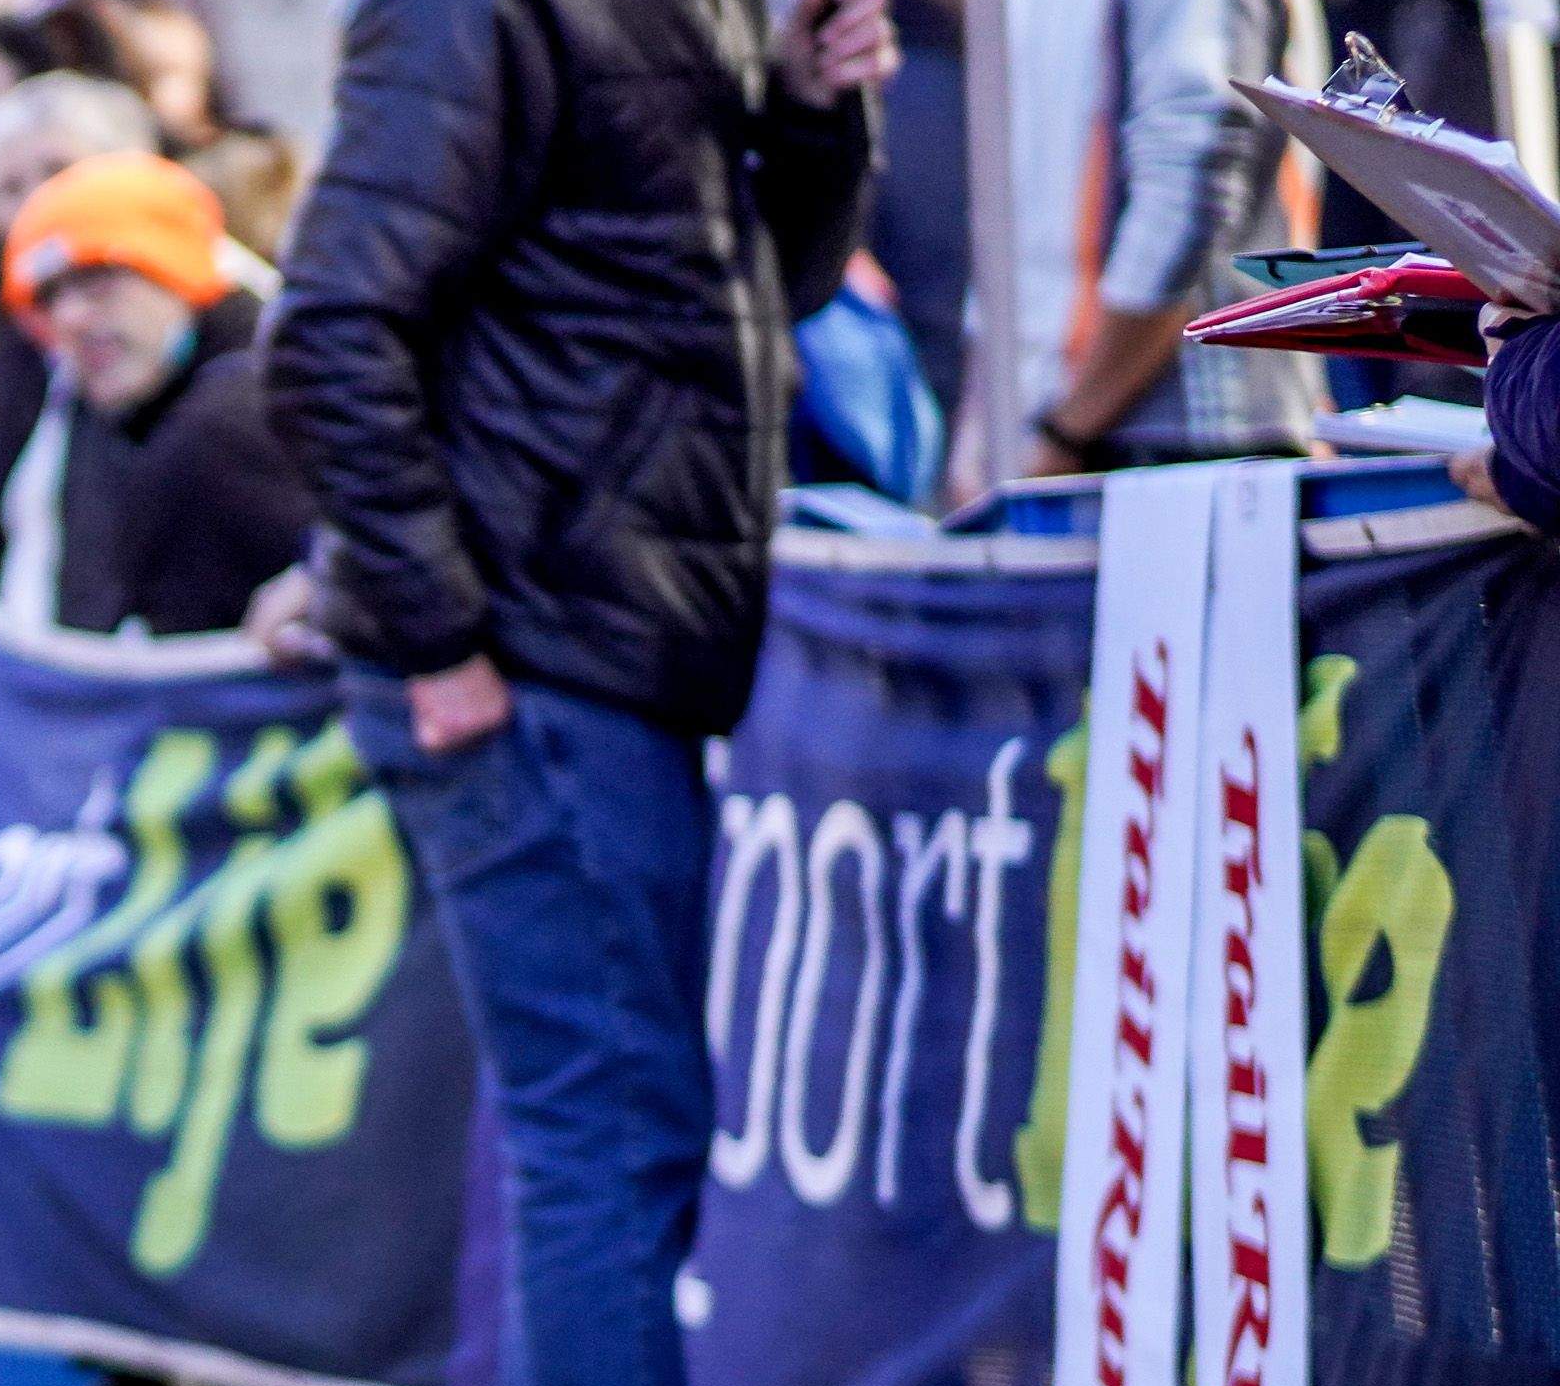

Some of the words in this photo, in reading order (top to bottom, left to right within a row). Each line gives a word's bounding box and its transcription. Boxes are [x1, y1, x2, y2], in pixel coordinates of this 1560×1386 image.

[705, 735, 1034, 1231] port
[1114, 637, 1170, 1069] Trail
[1221, 725, 1269, 1196] Trail
